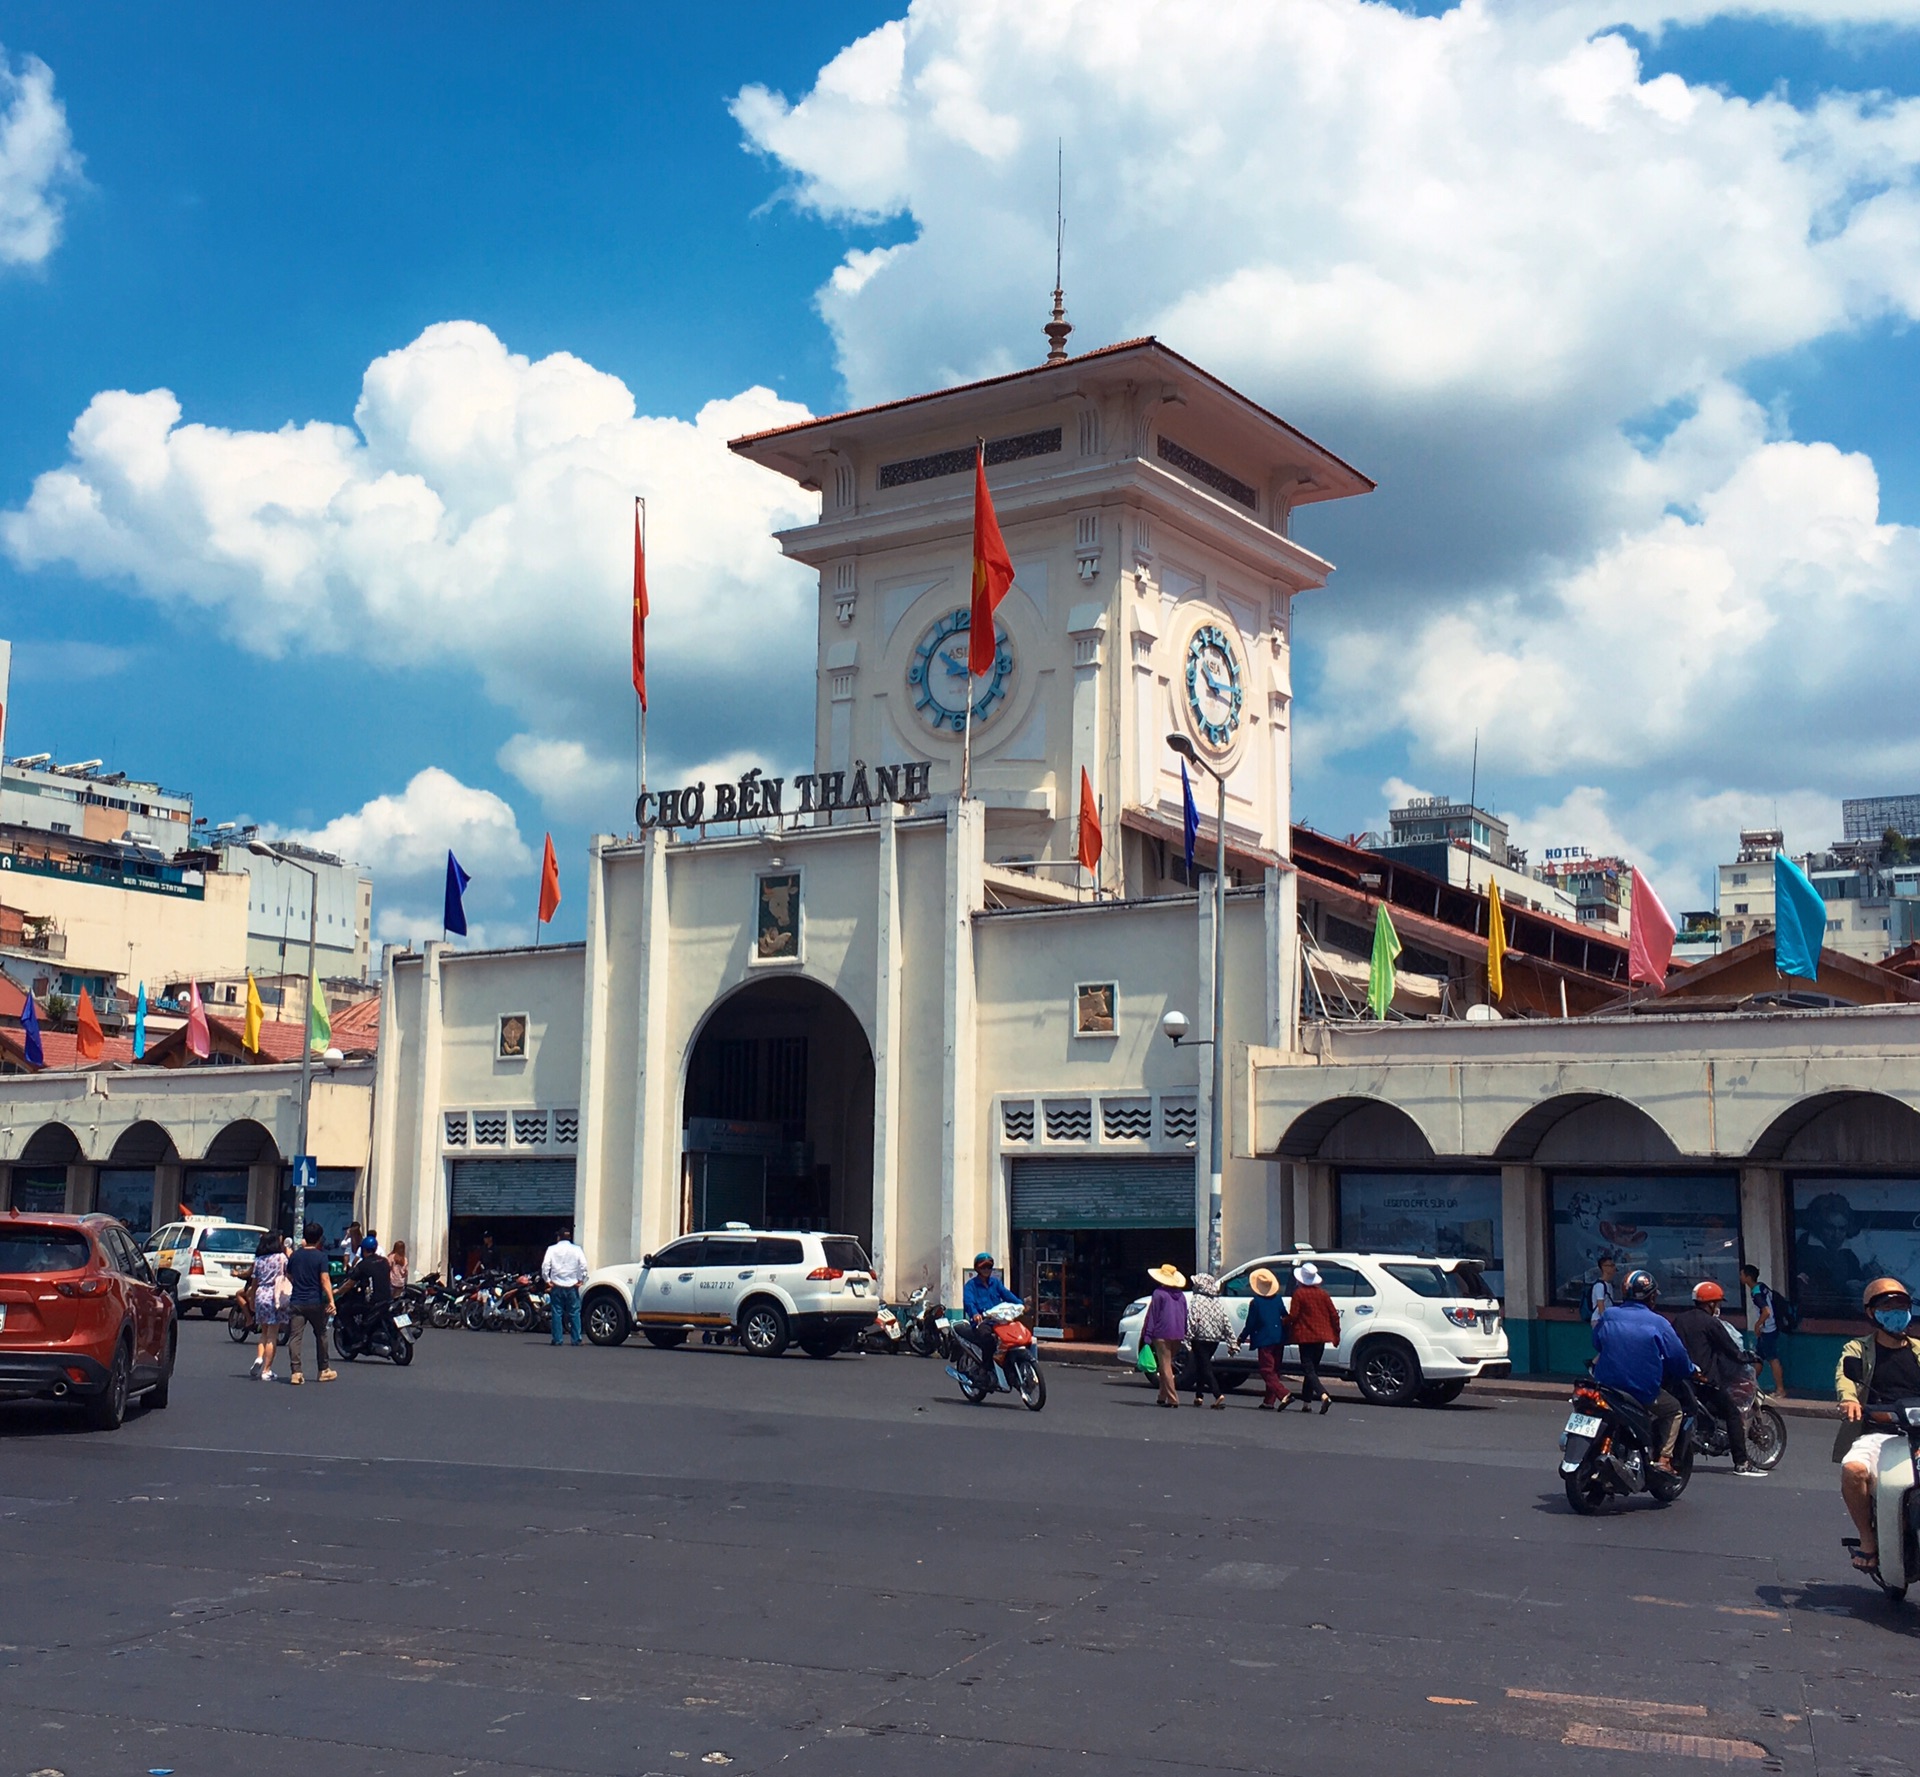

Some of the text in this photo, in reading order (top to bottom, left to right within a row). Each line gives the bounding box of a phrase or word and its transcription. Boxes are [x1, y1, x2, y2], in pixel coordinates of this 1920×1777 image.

[636, 759, 932, 829] CHỢ BẾN THÀNH
[1407, 796, 1450, 808] GOLDEN
[1391, 806, 1466, 819] CENTRAL HOTEL
[1545, 846, 1588, 859] HOTEL
